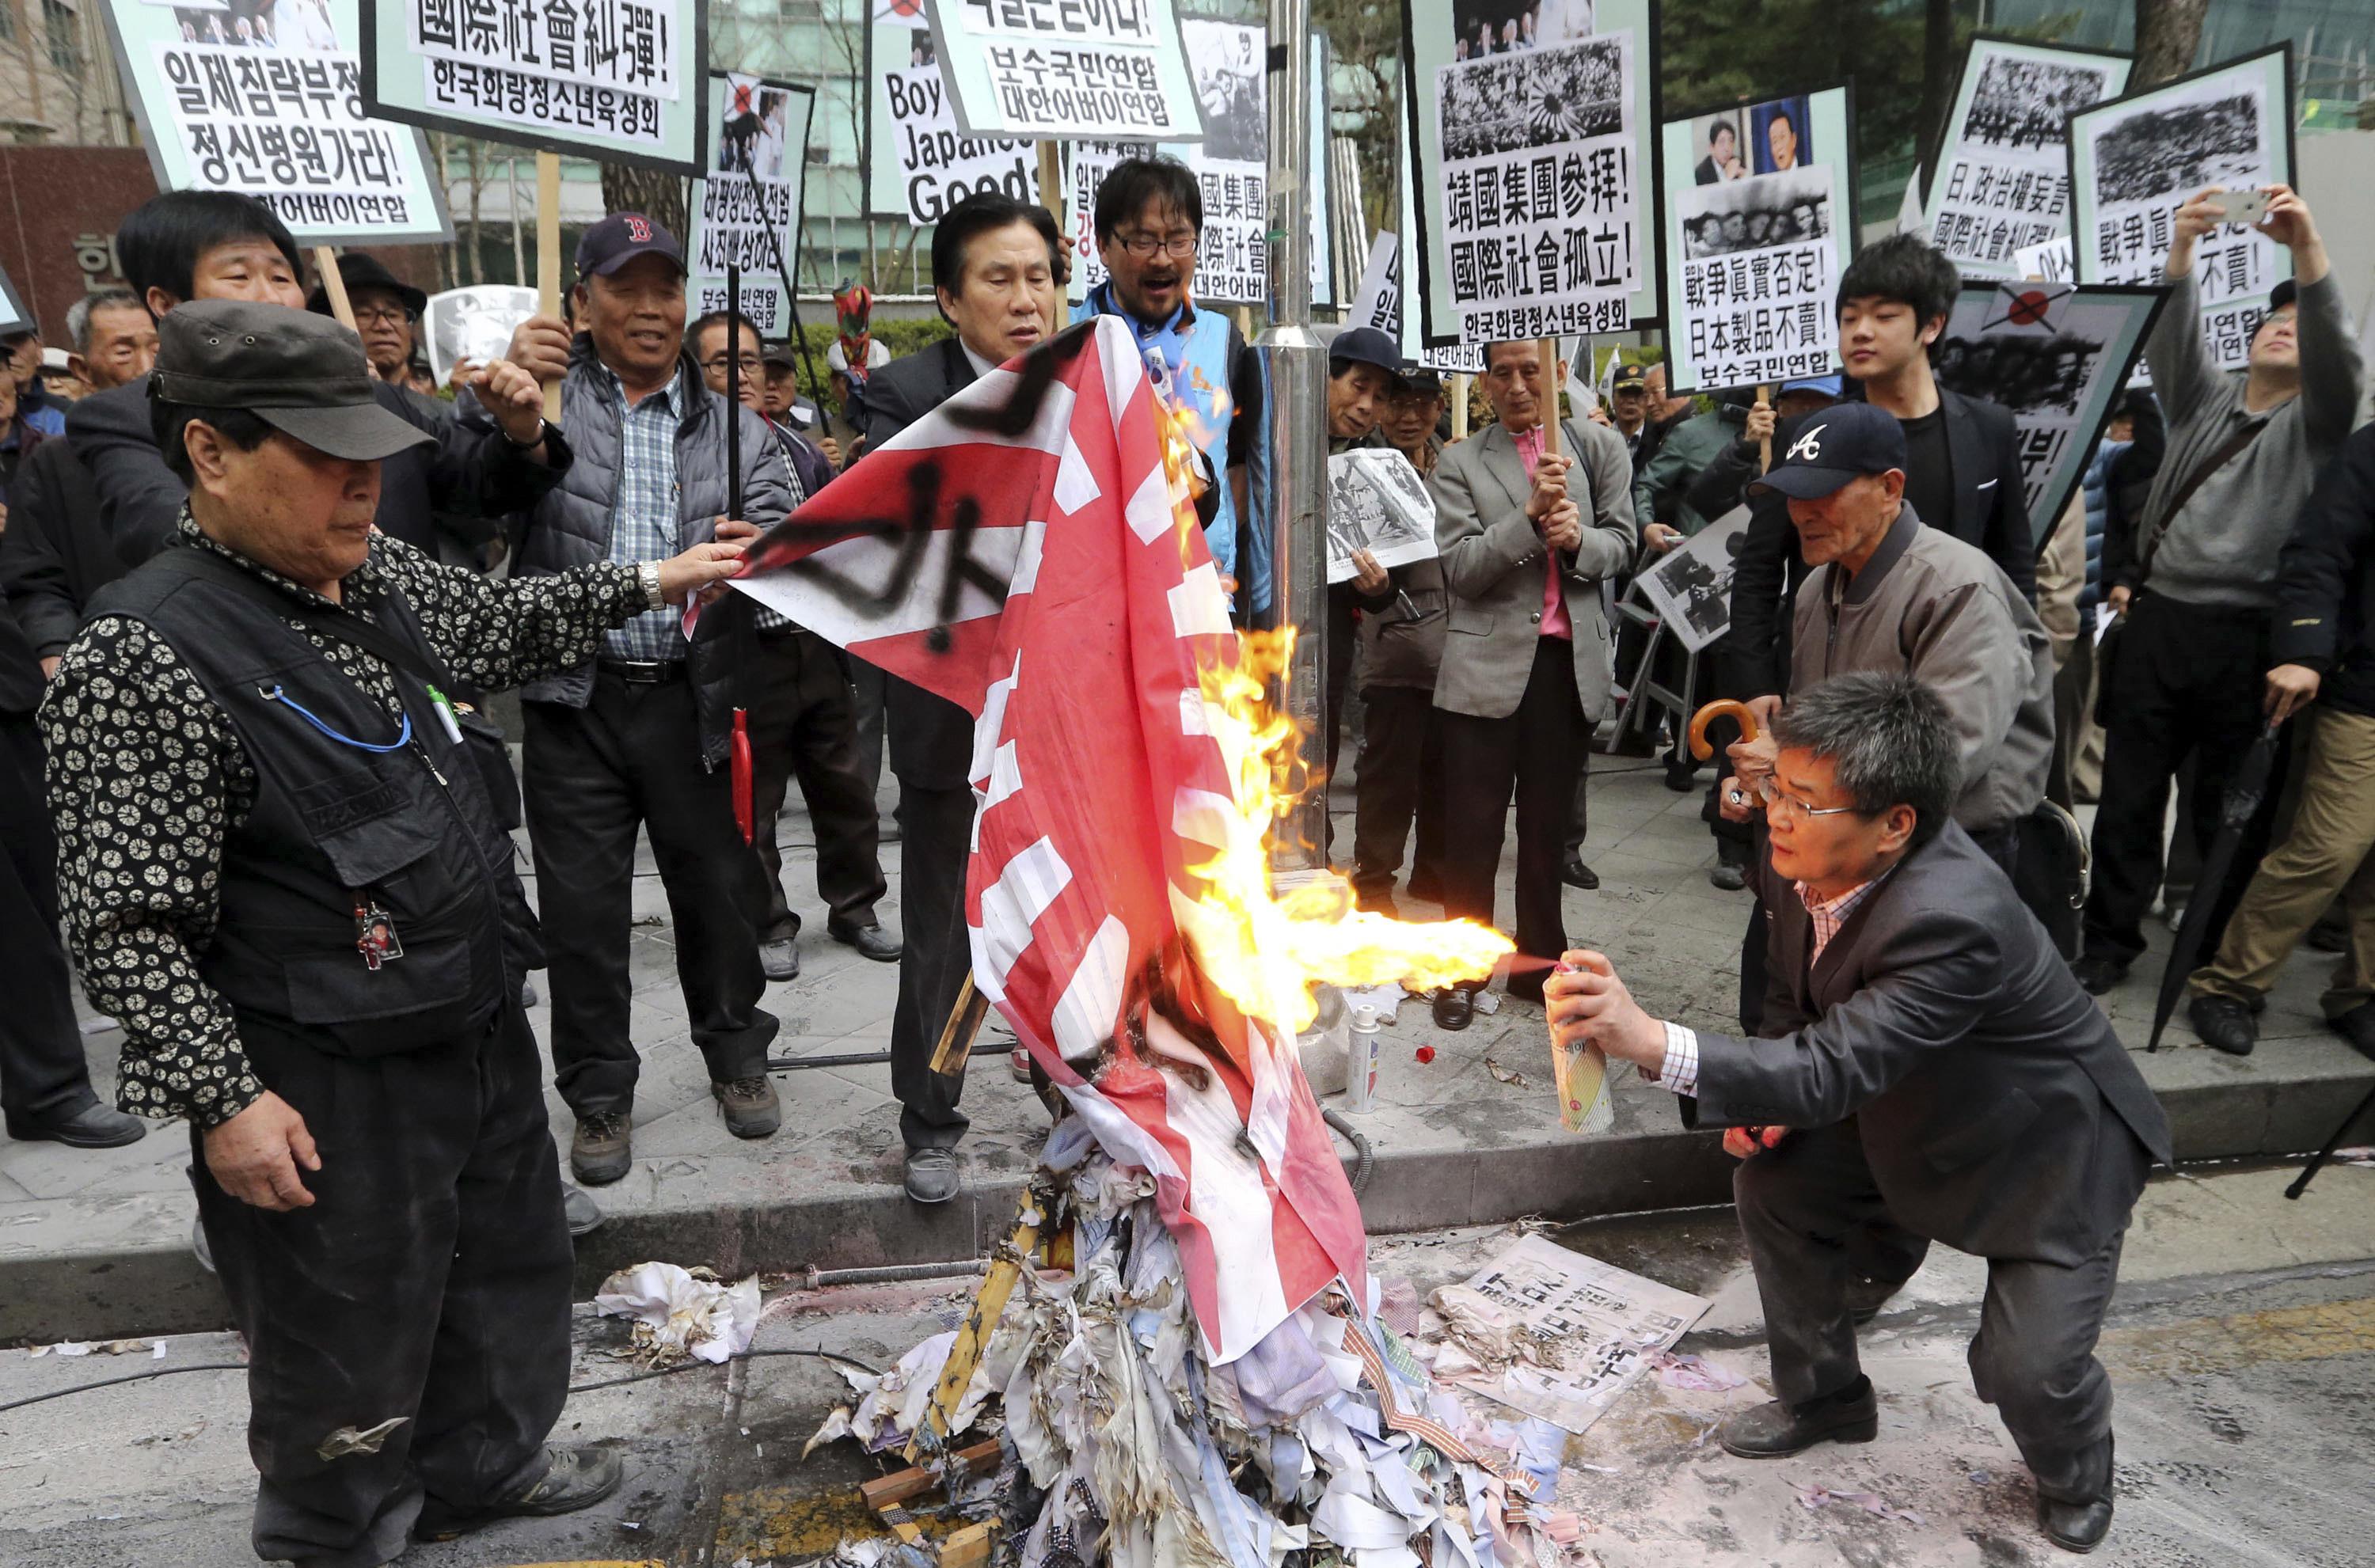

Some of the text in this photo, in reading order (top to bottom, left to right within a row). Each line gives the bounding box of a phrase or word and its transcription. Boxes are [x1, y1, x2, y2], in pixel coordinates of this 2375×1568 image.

[990, 47, 1157, 91] 보수국민연합
[886, 72, 940, 120] Boy
[1001, 85, 1169, 126] 대한어버이연합
[186, 123, 402, 187] 정신병원가라!
[903, 123, 1034, 170] Japan
[258, 194, 409, 224] 어버이연합
[1200, 172, 1264, 222] 國集團
[1447, 146, 1628, 233] 靖國集團參拜!
[624, 215, 652, 242] B
[1077, 212, 1092, 258] 강
[1203, 226, 1265, 274] 際社會
[1194, 273, 1262, 298] 대한어버
[1451, 222, 1632, 304] 國際社會孤立!
[2201, 241, 2259, 299] 不賣!
[701, 287, 777, 309] 보수민연합
[1465, 298, 1627, 342] 한국화랑청소년육성회
[1702, 349, 1830, 389] 보수국민연합
[1786, 423, 1828, 461] A
